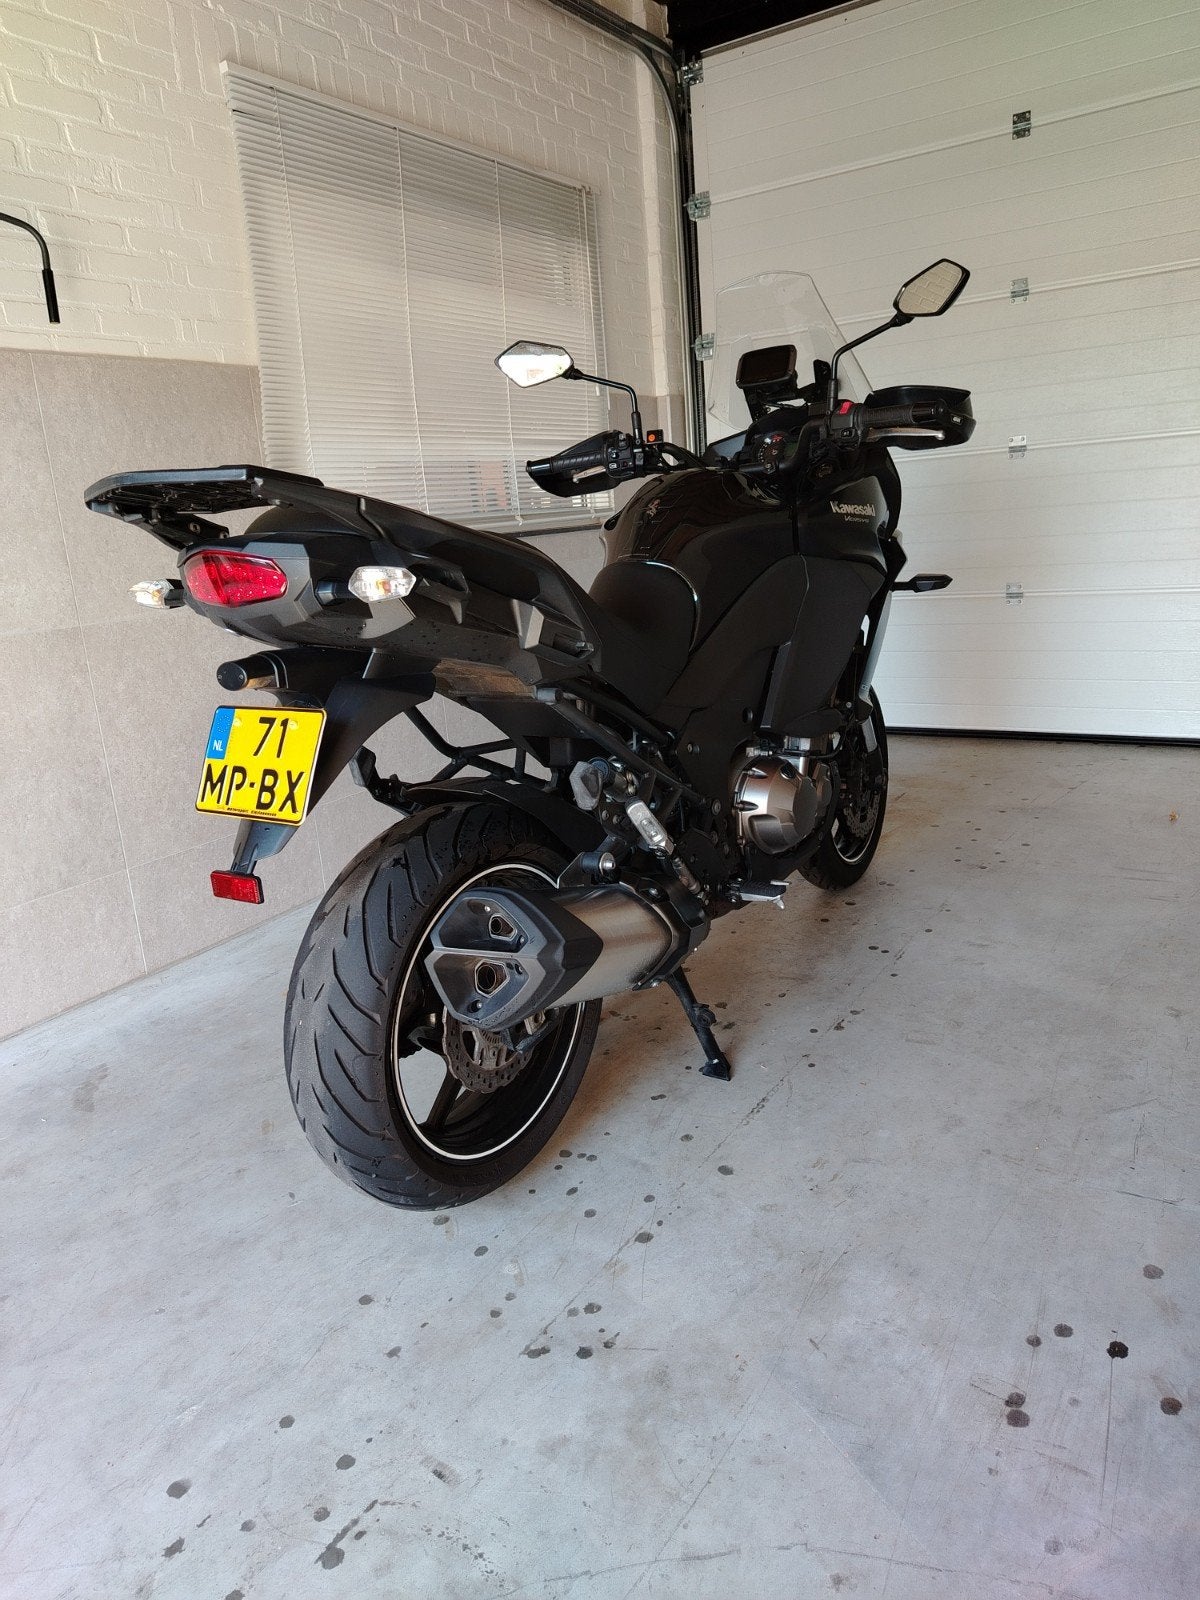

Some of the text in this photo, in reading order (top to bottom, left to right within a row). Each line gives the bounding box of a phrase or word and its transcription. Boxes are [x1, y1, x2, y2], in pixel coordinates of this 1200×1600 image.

[830, 500, 876, 517] Kawasaki
[212, 739, 224, 752] NL
[253, 716, 289, 759] 71
[200, 763, 305, 814] MP-BX
